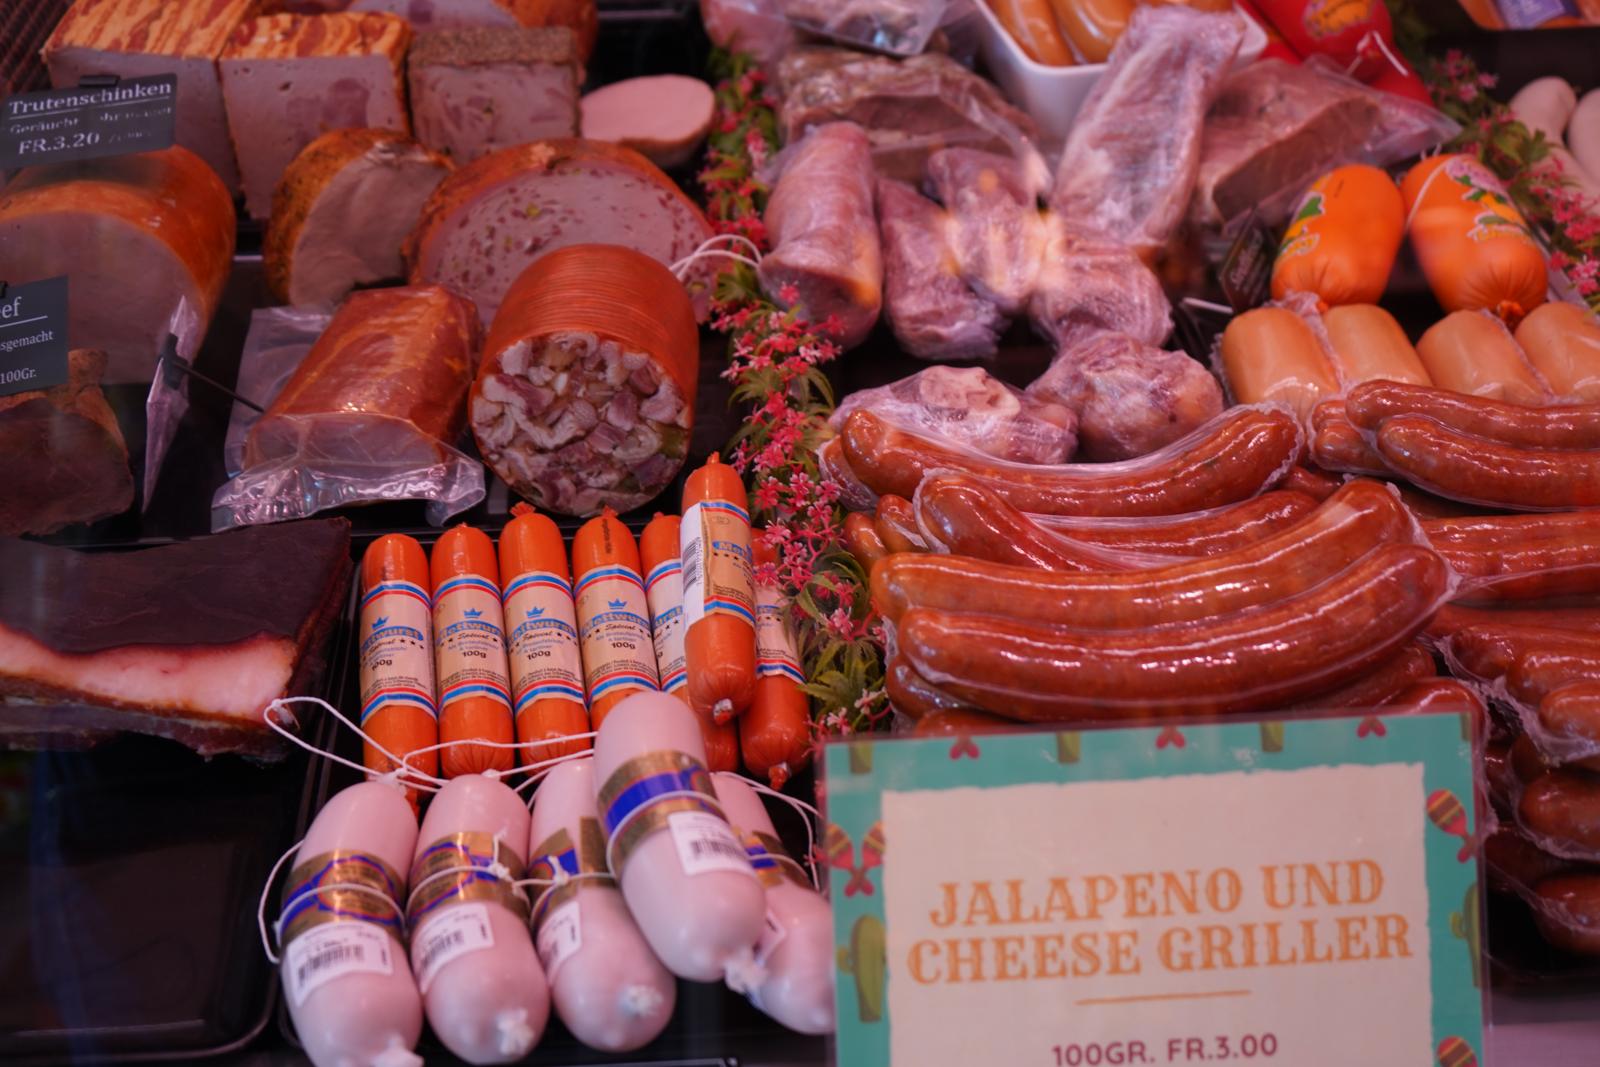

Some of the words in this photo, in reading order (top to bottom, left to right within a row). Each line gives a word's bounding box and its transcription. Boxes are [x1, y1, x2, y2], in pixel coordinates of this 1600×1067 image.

[9, 83, 172, 114] Trutenschinken
[18, 132, 99, 154] FR.3.20
[462, 650, 487, 659] 100g
[527, 650, 552, 660] 100g
[611, 641, 636, 650] 100g
[929, 867, 1242, 927] JALAPENO
[1260, 858, 1384, 911] UND
[906, 930, 1140, 985] CHEESE
[1157, 912, 1413, 972] GRILLER
[1052, 1040, 1154, 1067] 100GR.
[1168, 1033, 1278, 1064] FR.3.00
